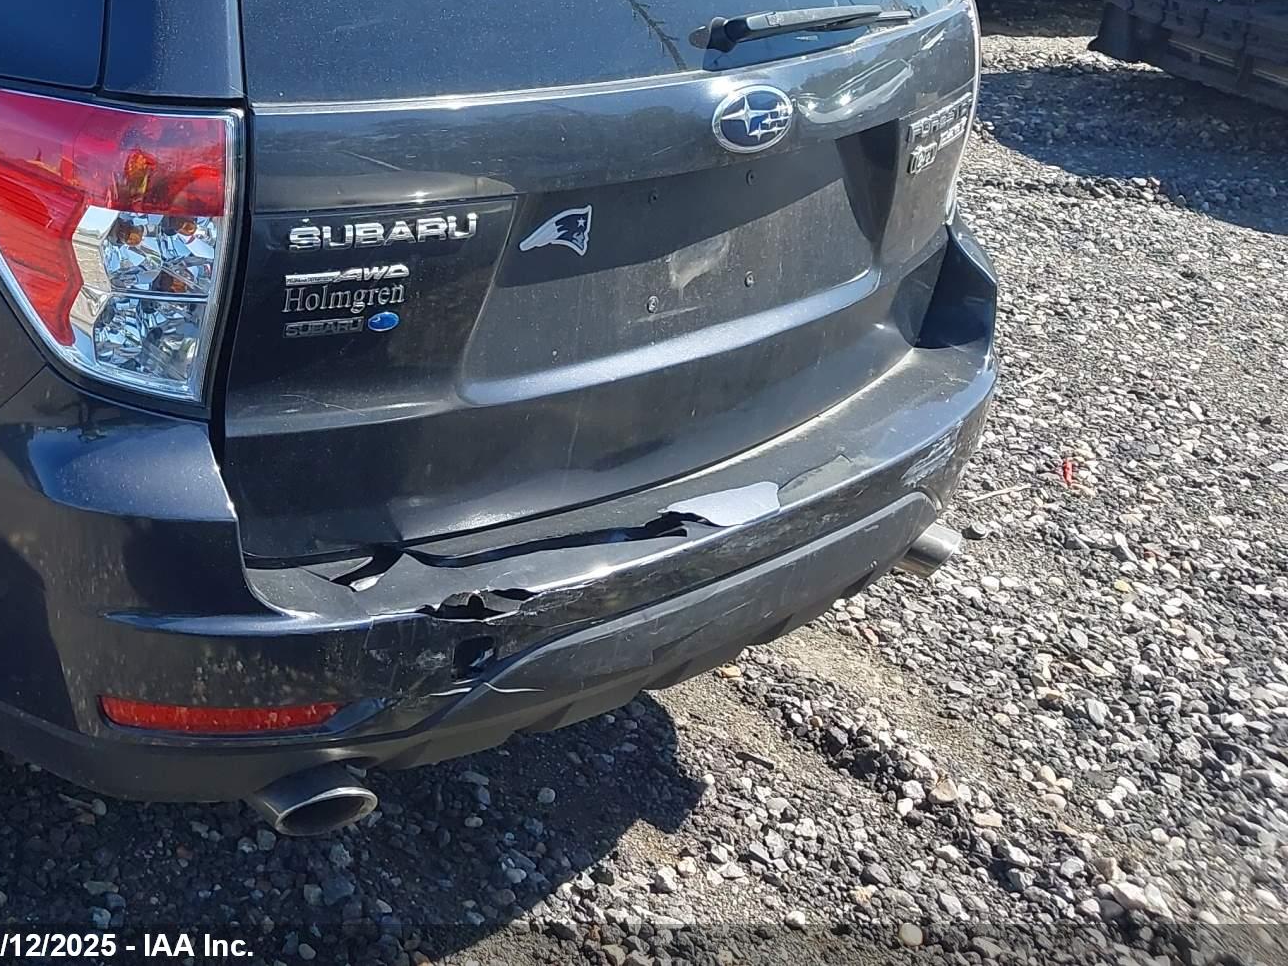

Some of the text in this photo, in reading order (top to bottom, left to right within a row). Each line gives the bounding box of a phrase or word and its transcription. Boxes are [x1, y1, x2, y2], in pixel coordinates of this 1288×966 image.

[288, 212, 478, 252] SUBARU
[336, 263, 411, 283] AWD
[281, 284, 406, 315] Holmgren
[284, 316, 365, 338] SUBARU
